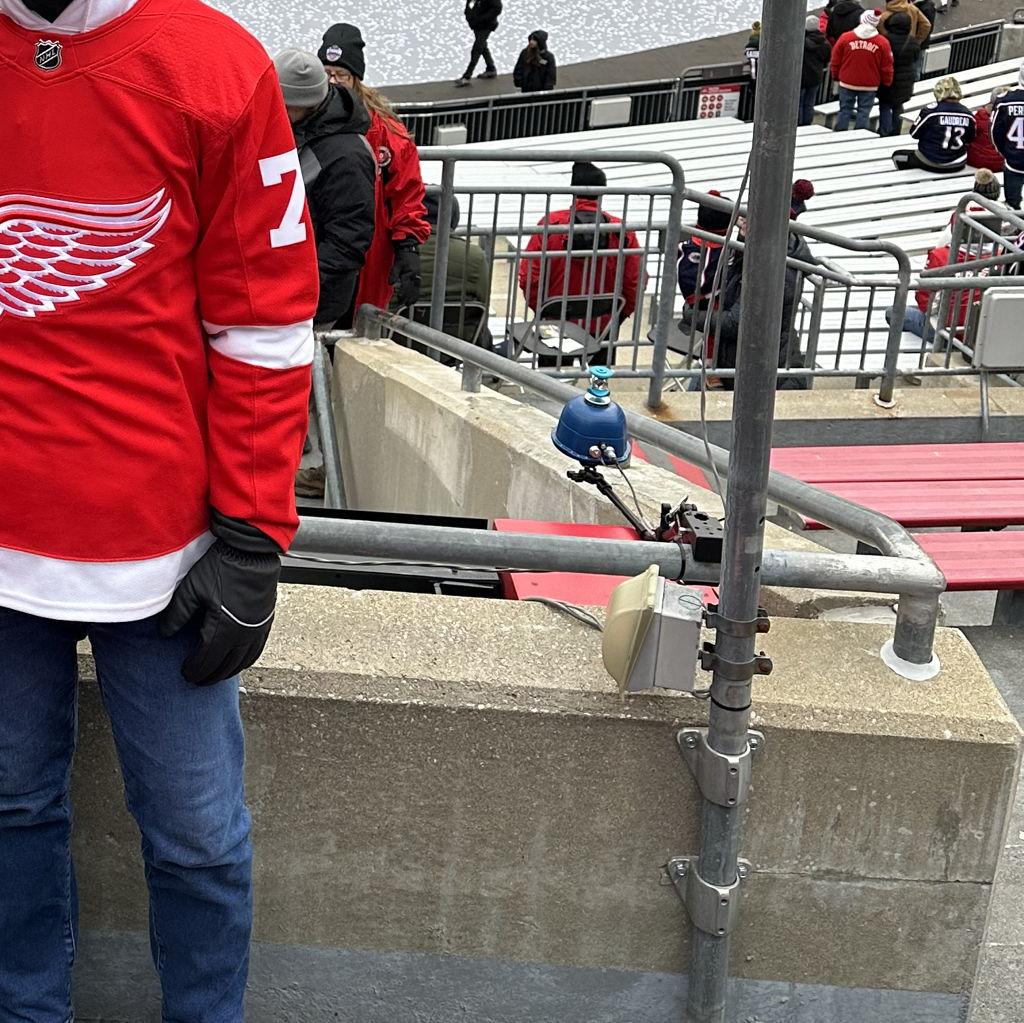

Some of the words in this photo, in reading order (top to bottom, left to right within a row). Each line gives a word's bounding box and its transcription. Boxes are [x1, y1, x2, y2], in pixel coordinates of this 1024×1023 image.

[848, 40, 879, 54] DETROIT
[39, 48, 56, 64] NHL
[939, 115, 970, 127] GAUDREAU
[941, 126, 966, 150] 13
[258, 148, 307, 248] 7
